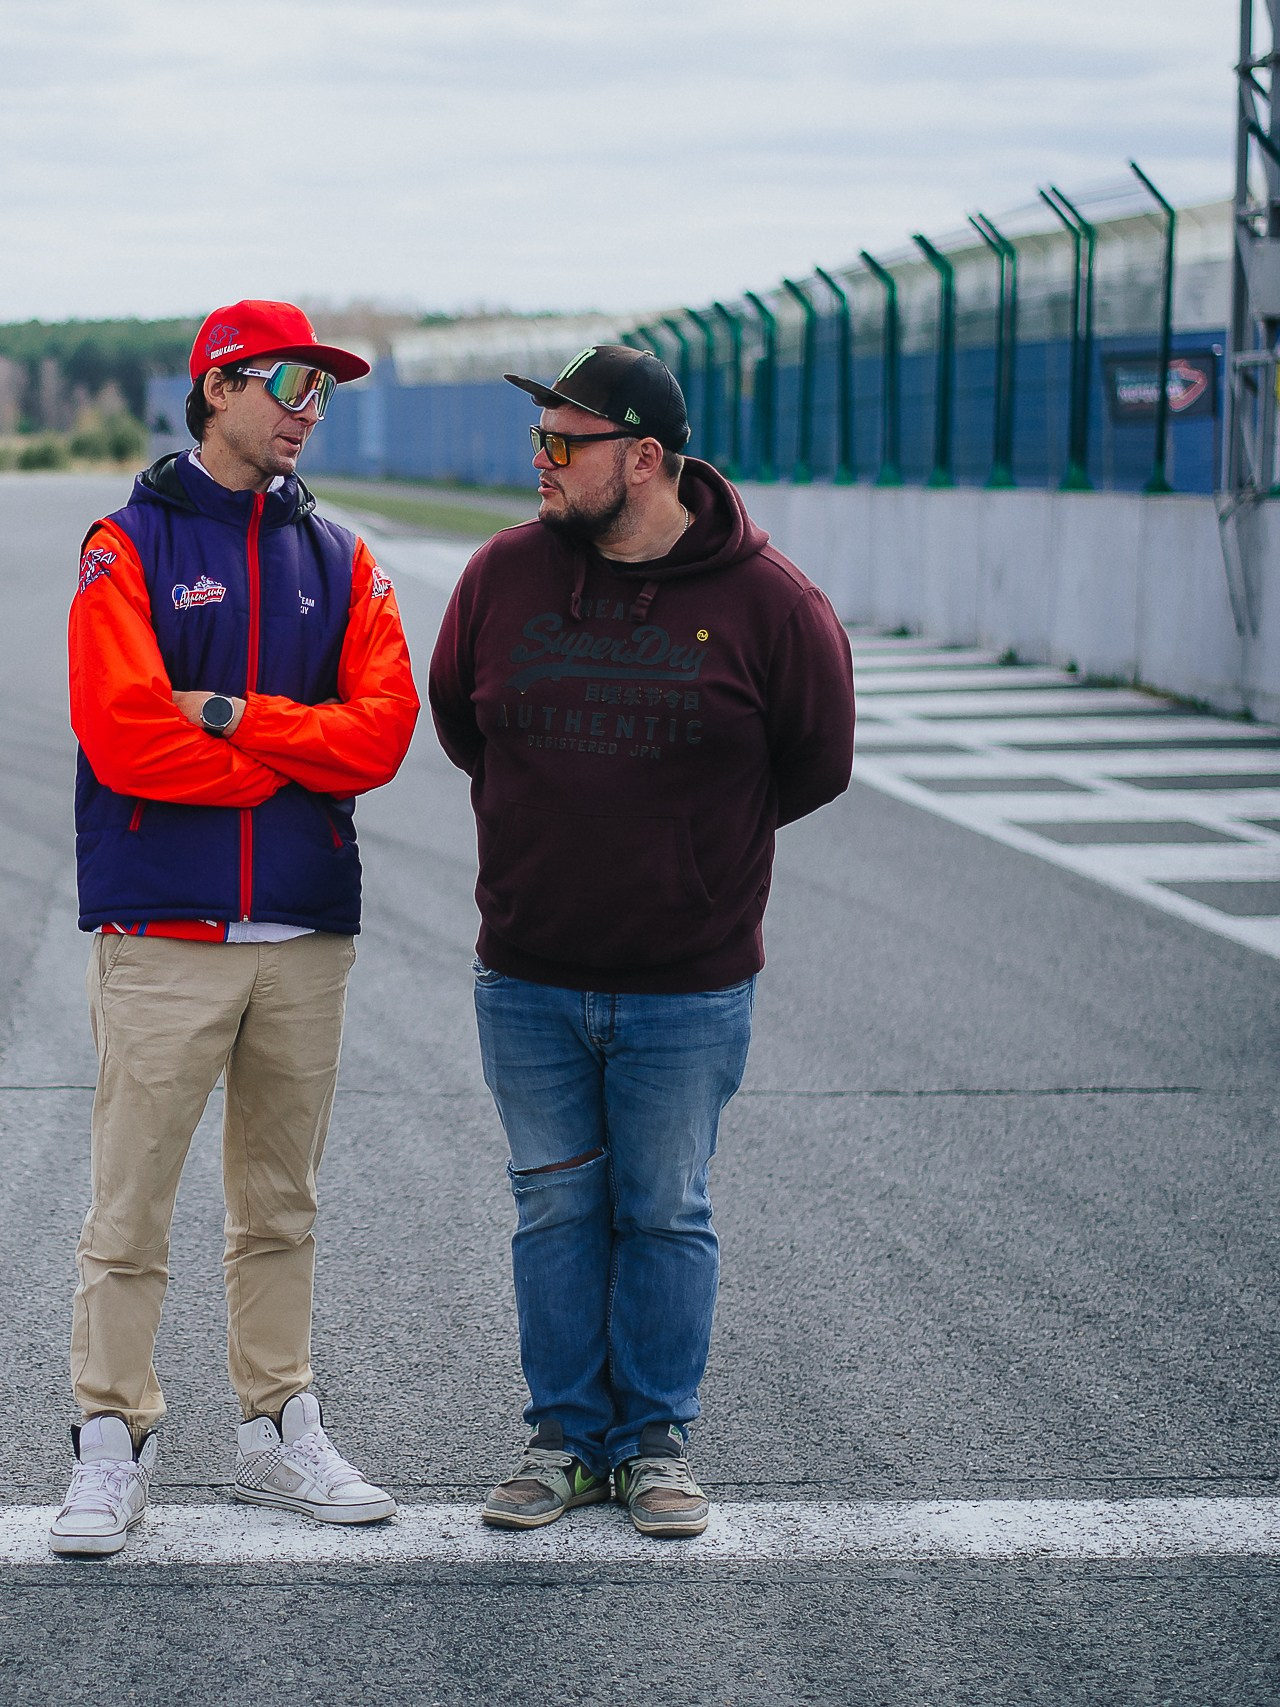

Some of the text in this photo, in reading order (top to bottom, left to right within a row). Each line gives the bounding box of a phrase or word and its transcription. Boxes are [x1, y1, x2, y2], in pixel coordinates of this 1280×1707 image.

[497, 703, 704, 744] AUTHENTIC
[528, 734, 662, 760] REGISTERED JPN
